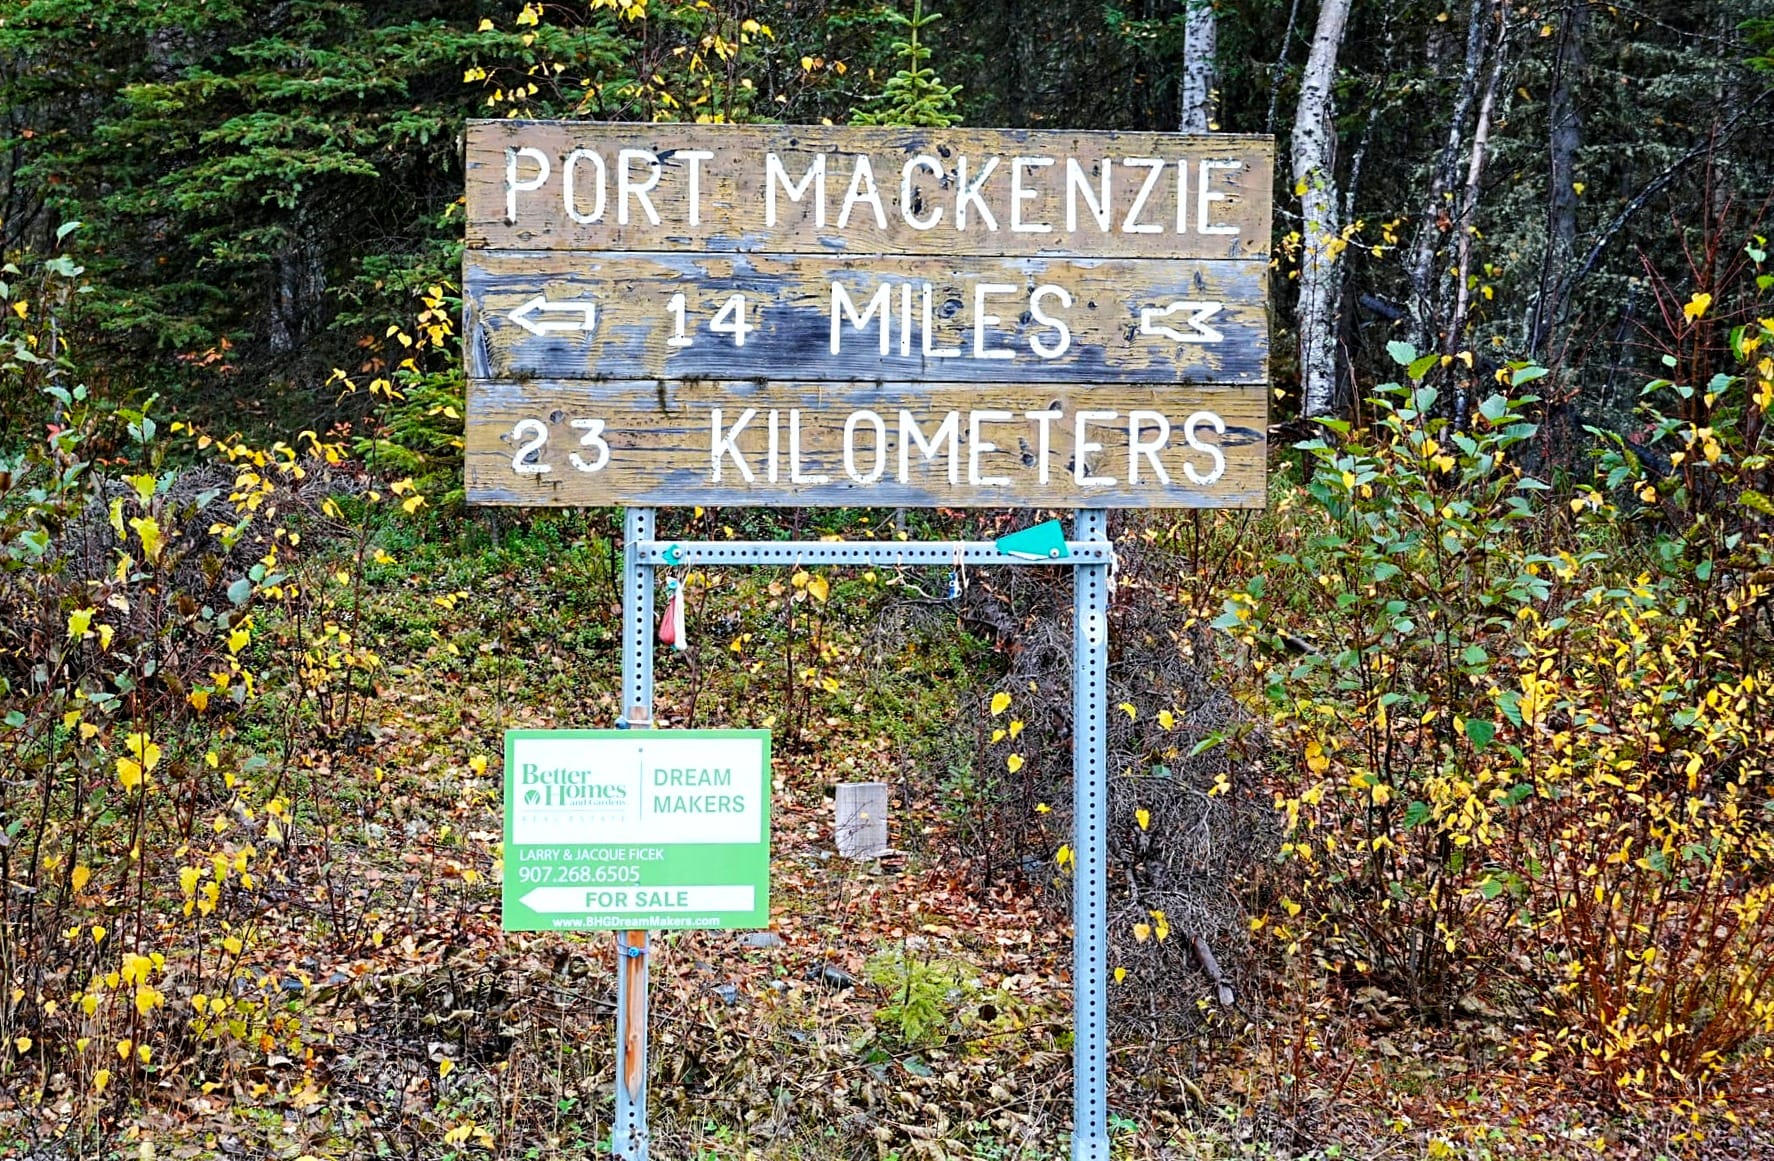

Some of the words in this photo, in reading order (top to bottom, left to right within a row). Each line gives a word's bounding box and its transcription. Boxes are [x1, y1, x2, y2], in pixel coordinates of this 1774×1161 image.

[505, 146, 715, 228] PORT
[765, 150, 1243, 236] MACKENZIE
[667, 293, 753, 348] 14
[829, 280, 1073, 359] MILES
[511, 417, 611, 474] 23
[710, 407, 1228, 487] KILOMETERS
[522, 763, 592, 785] Better
[654, 768, 731, 786] DREAM
[545, 783, 627, 806] Homes
[569, 798, 586, 806] and
[653, 795, 745, 813] MAKERS
[519, 848, 560, 862] LARRY
[563, 848, 573, 862] &
[575, 848, 626, 863] JACQUE
[628, 847, 664, 861] FICEK
[518, 865, 640, 884] 907.268.6505
[586, 892, 628, 908] FOR
[635, 891, 689, 907] SALE
[552, 916, 721, 928] www.BHGDreamMakers.com
